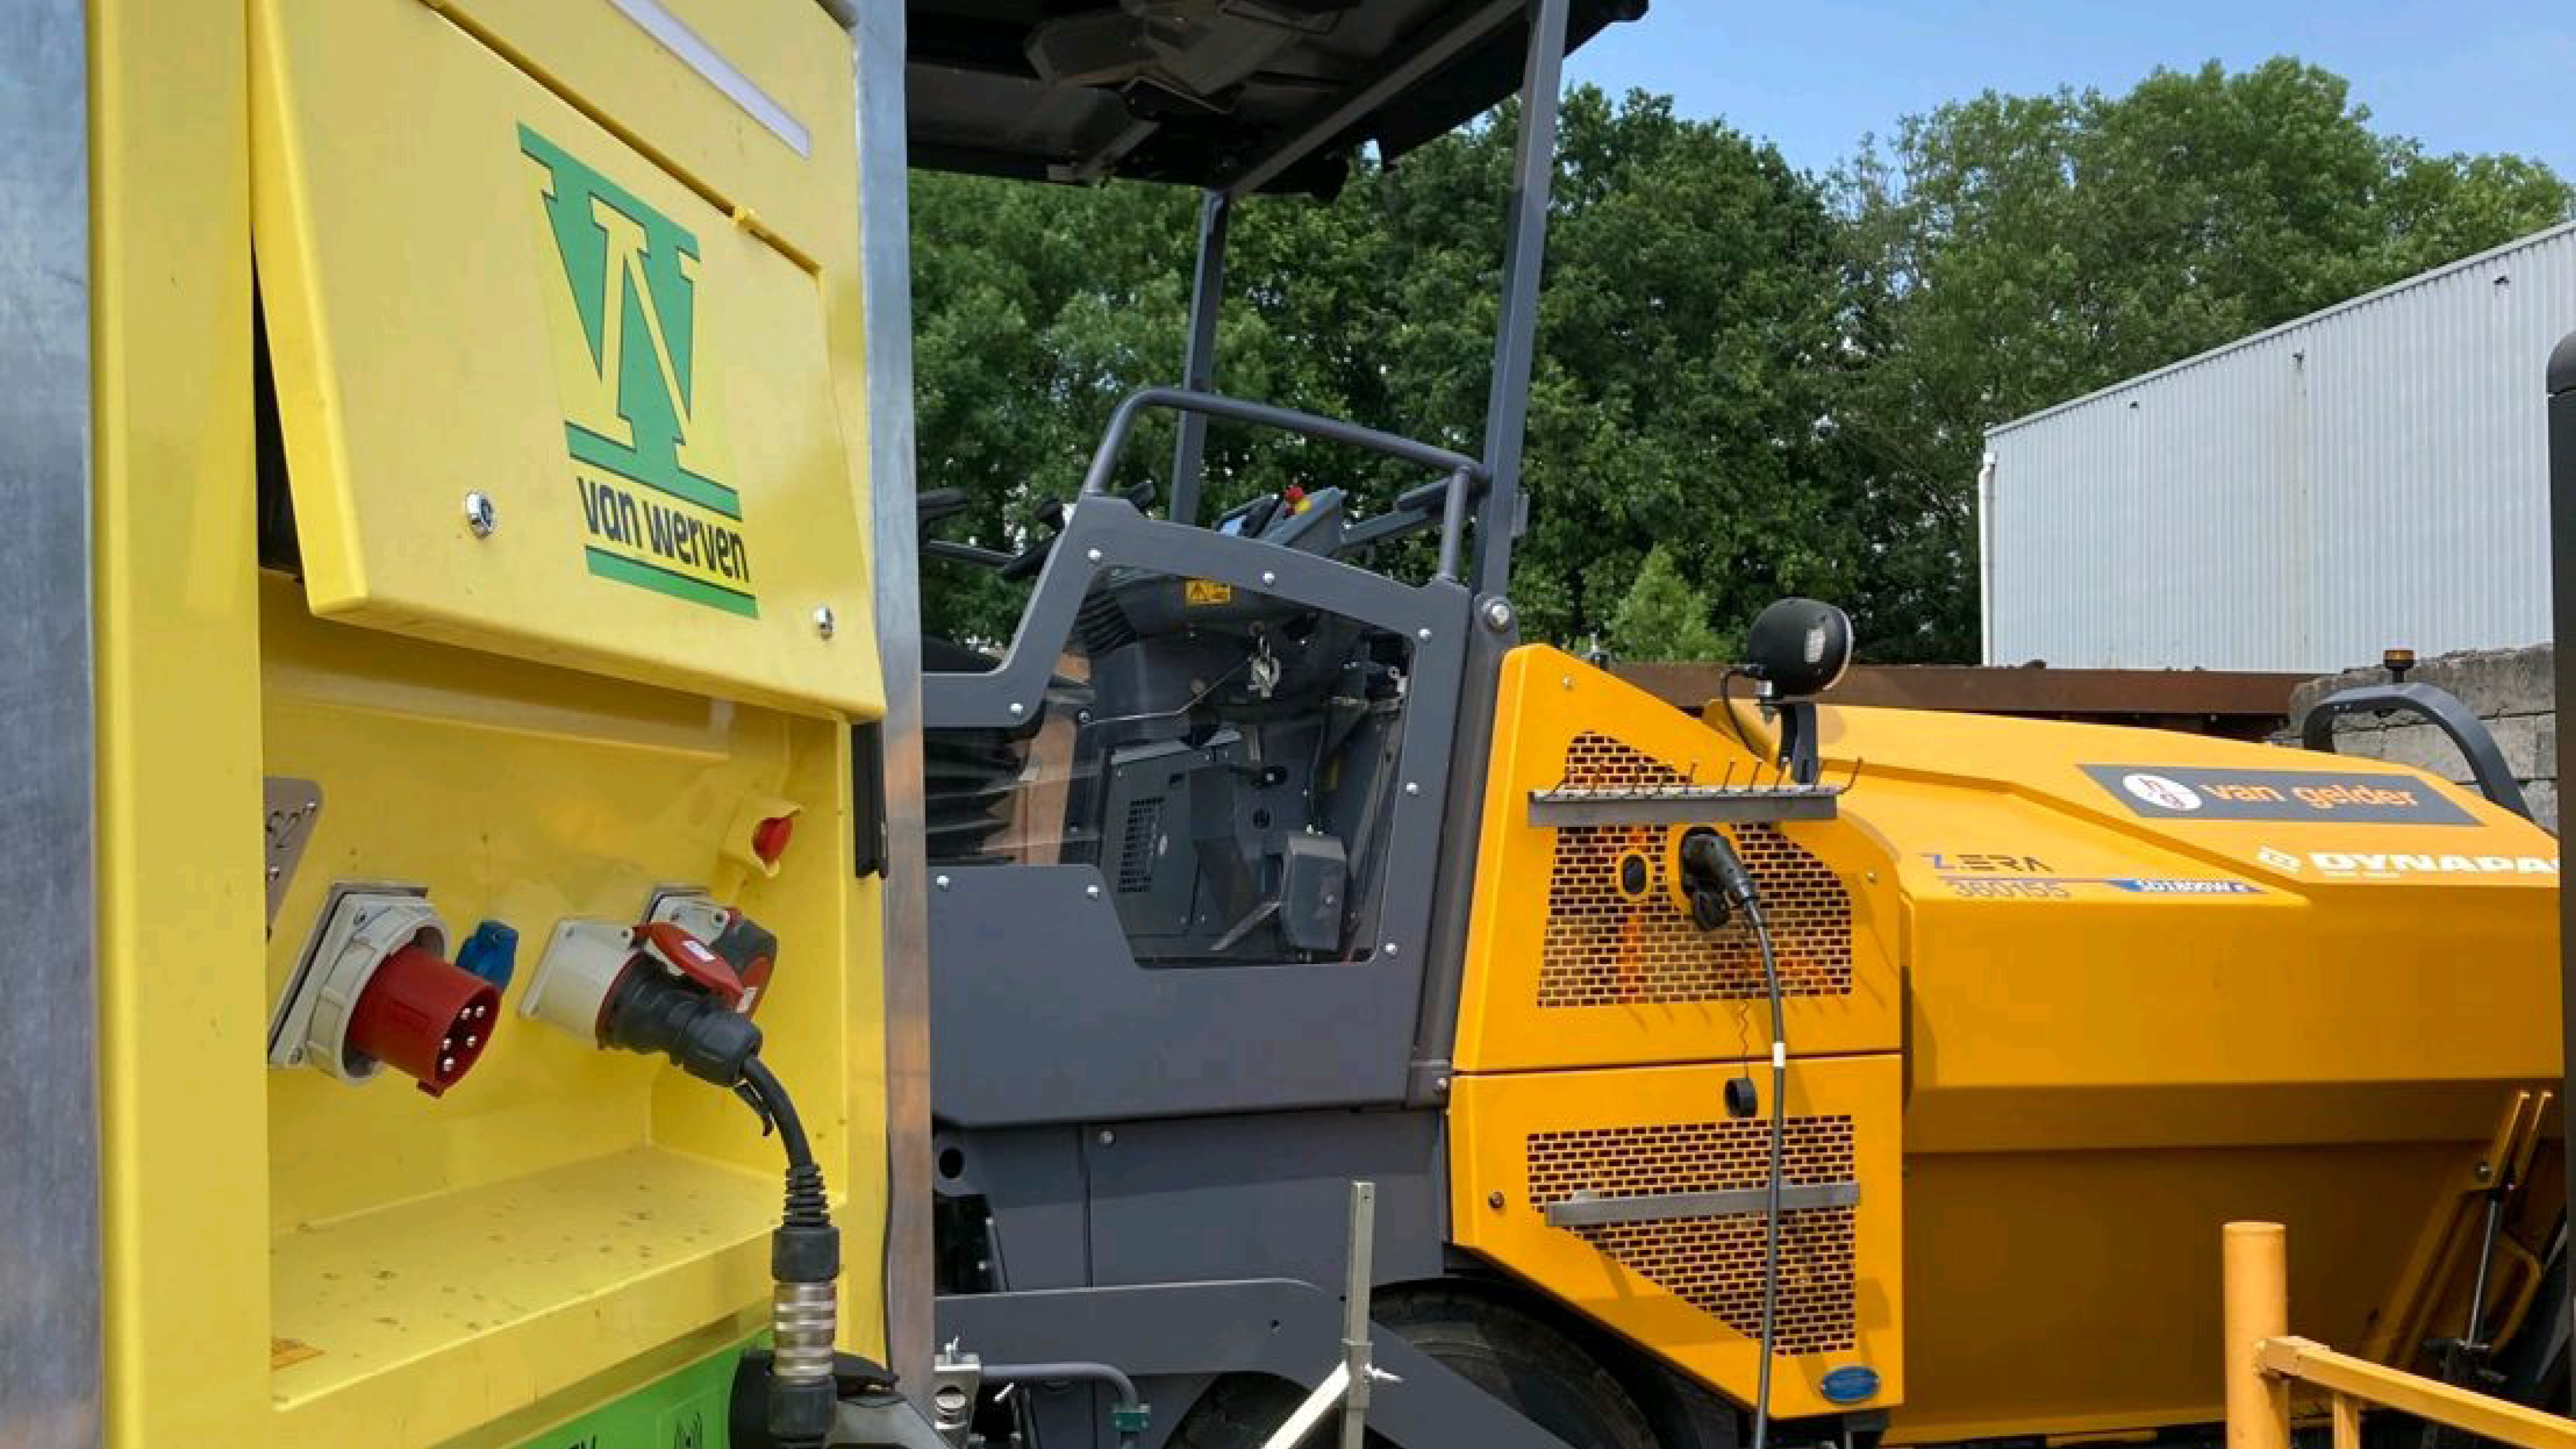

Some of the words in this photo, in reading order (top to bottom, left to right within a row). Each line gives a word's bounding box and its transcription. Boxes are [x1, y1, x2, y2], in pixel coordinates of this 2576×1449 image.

[576, 475, 643, 549] van
[641, 500, 750, 583] werven
[2199, 784, 2287, 802] van
[2291, 784, 2420, 810] gelder
[2307, 852, 2559, 873] DYNAPA
